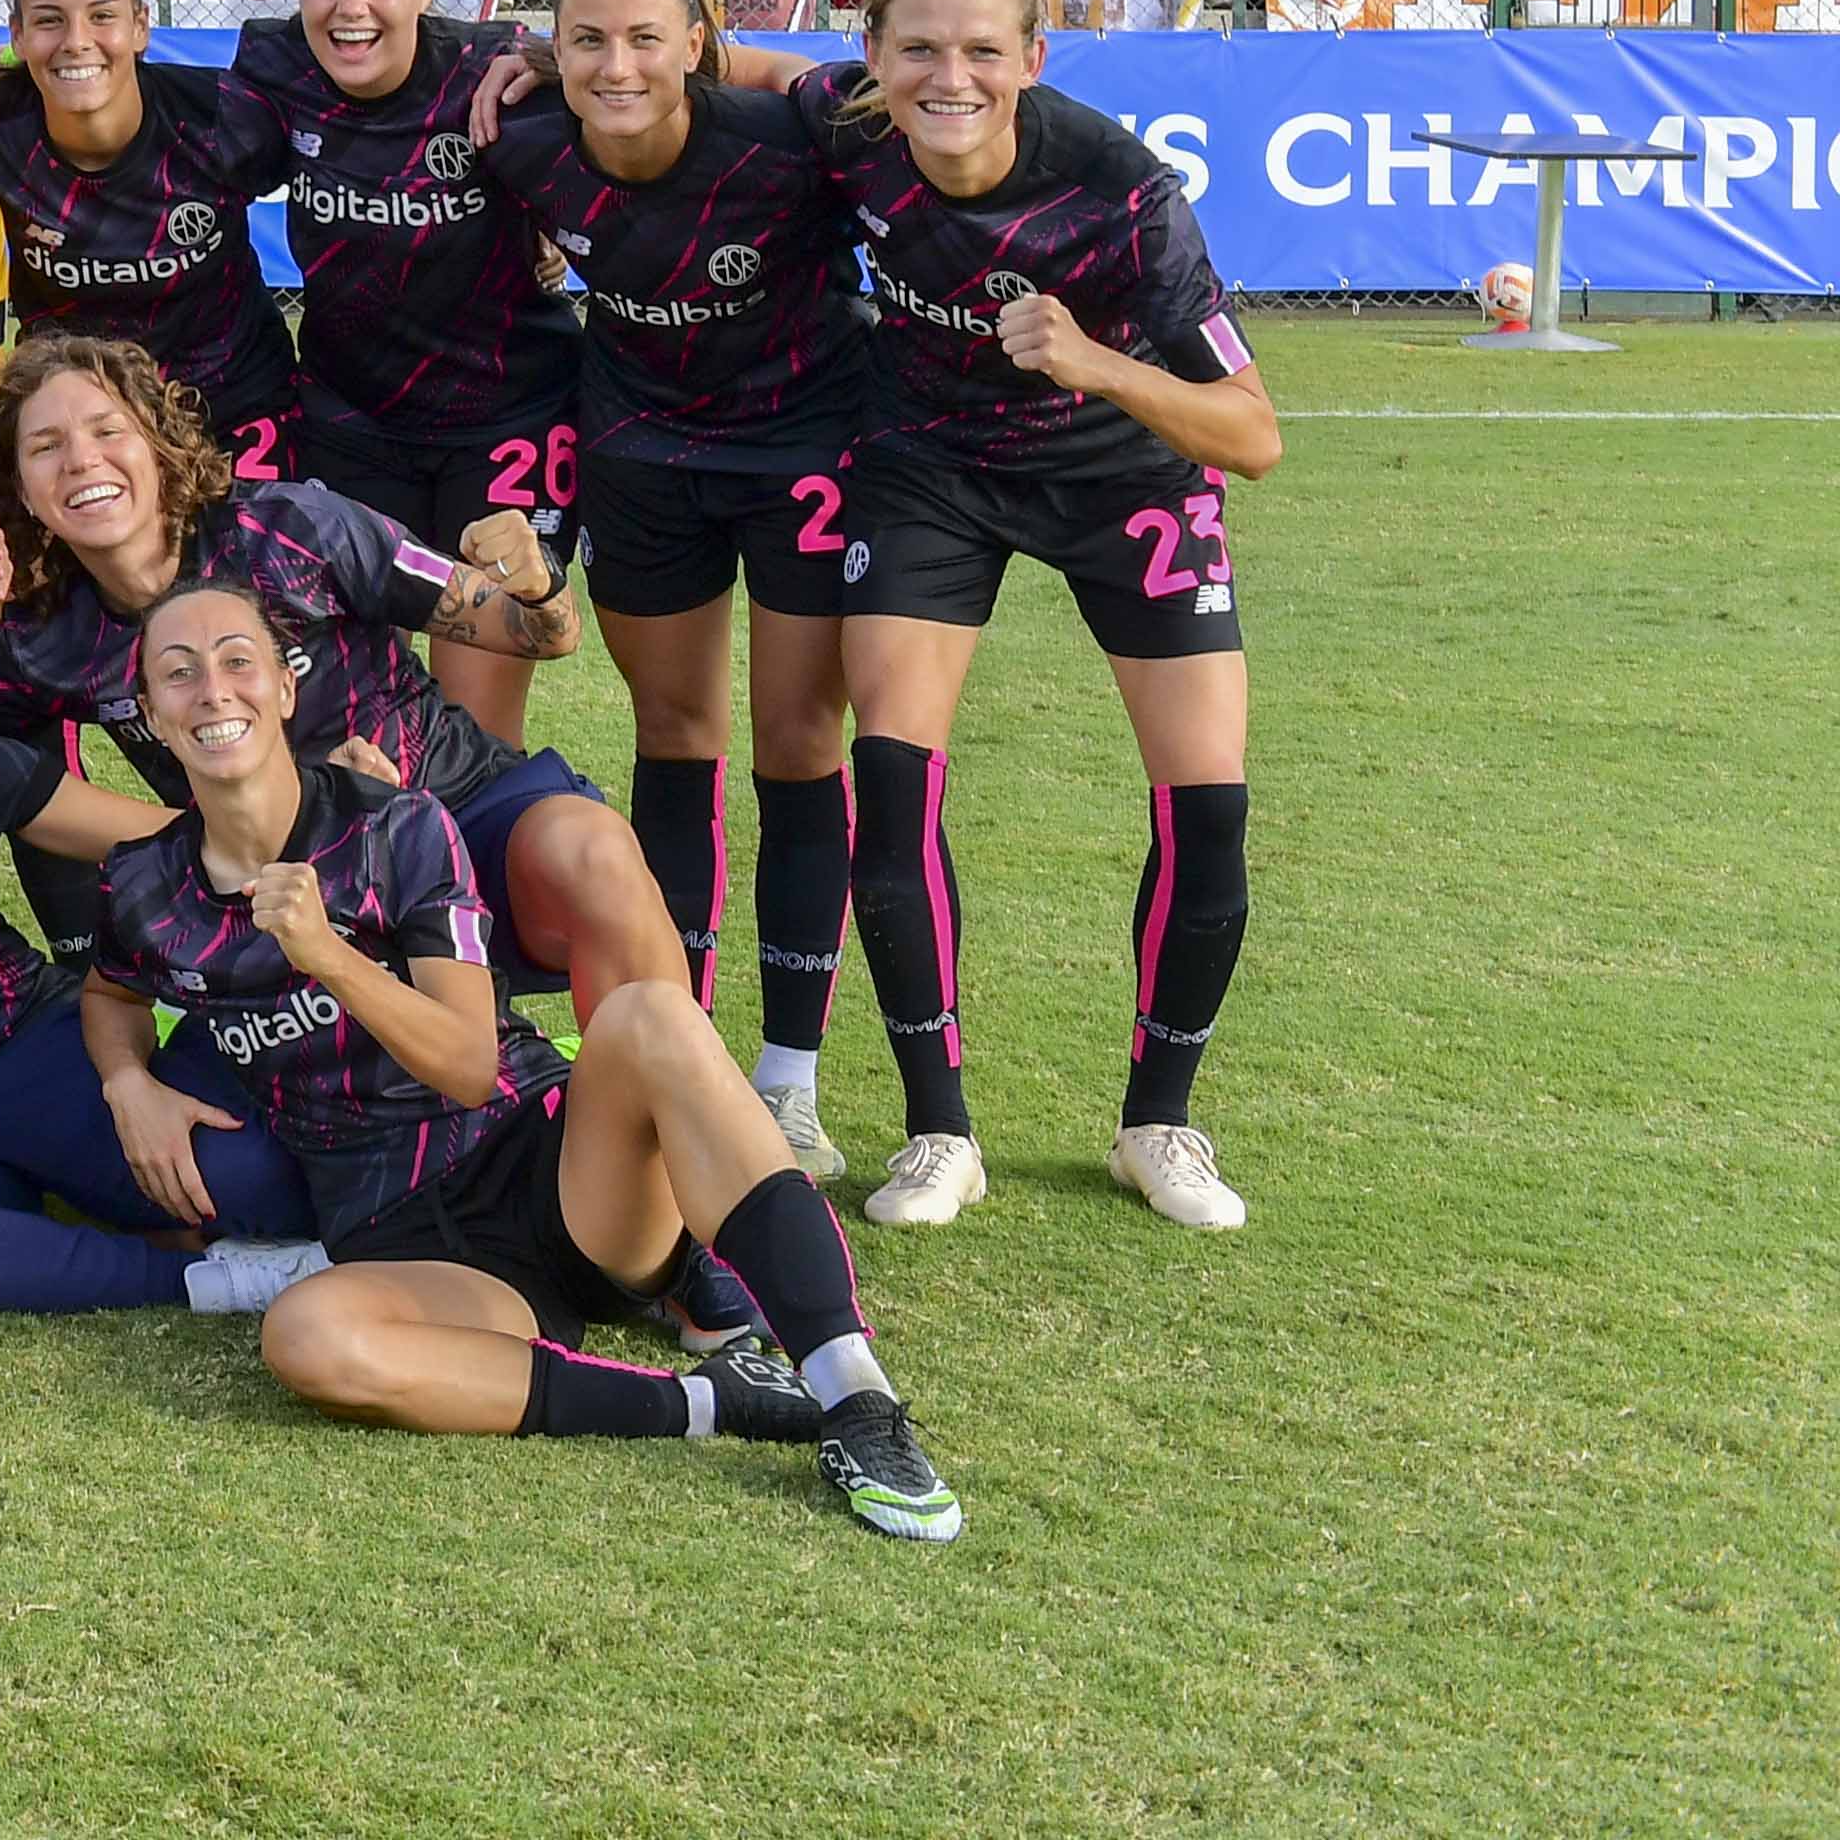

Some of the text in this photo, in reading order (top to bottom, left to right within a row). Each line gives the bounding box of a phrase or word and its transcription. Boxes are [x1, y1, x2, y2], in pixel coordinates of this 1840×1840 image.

[425, 134, 474, 180] ASR
[1266, 113, 1840, 210] CHAMPI
[168, 202, 218, 247] ASR
[293, 173, 485, 227] digitalbits
[24, 232, 223, 288] digitalbits
[709, 244, 760, 286] ASR
[488, 425, 576, 506] 26
[791, 475, 844, 552] 2
[1127, 493, 1231, 598] 23
